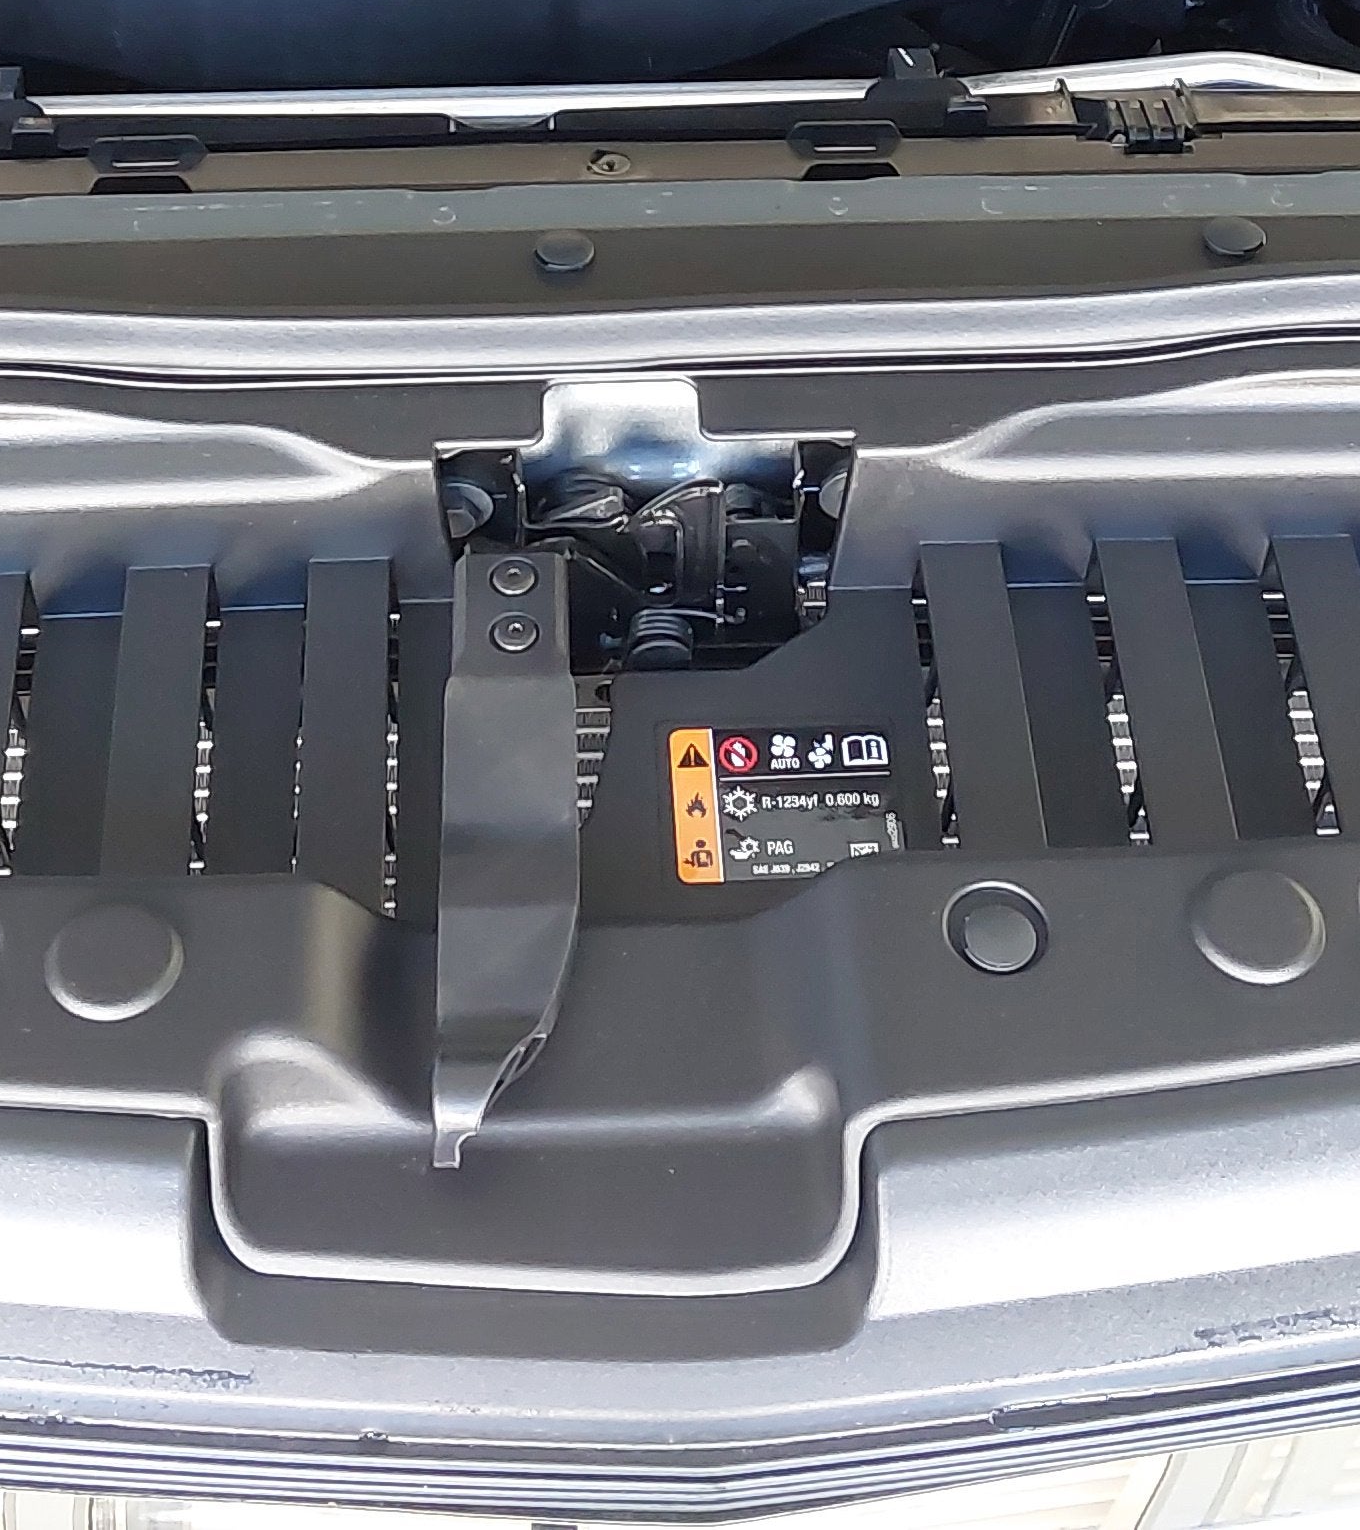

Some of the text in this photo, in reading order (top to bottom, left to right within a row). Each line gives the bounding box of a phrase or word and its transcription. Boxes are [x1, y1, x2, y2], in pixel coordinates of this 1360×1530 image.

[771, 759, 800, 770] AUTO
[825, 793, 860, 807] 0.600
[863, 792, 879, 807] kg
[767, 841, 794, 855] PAG
